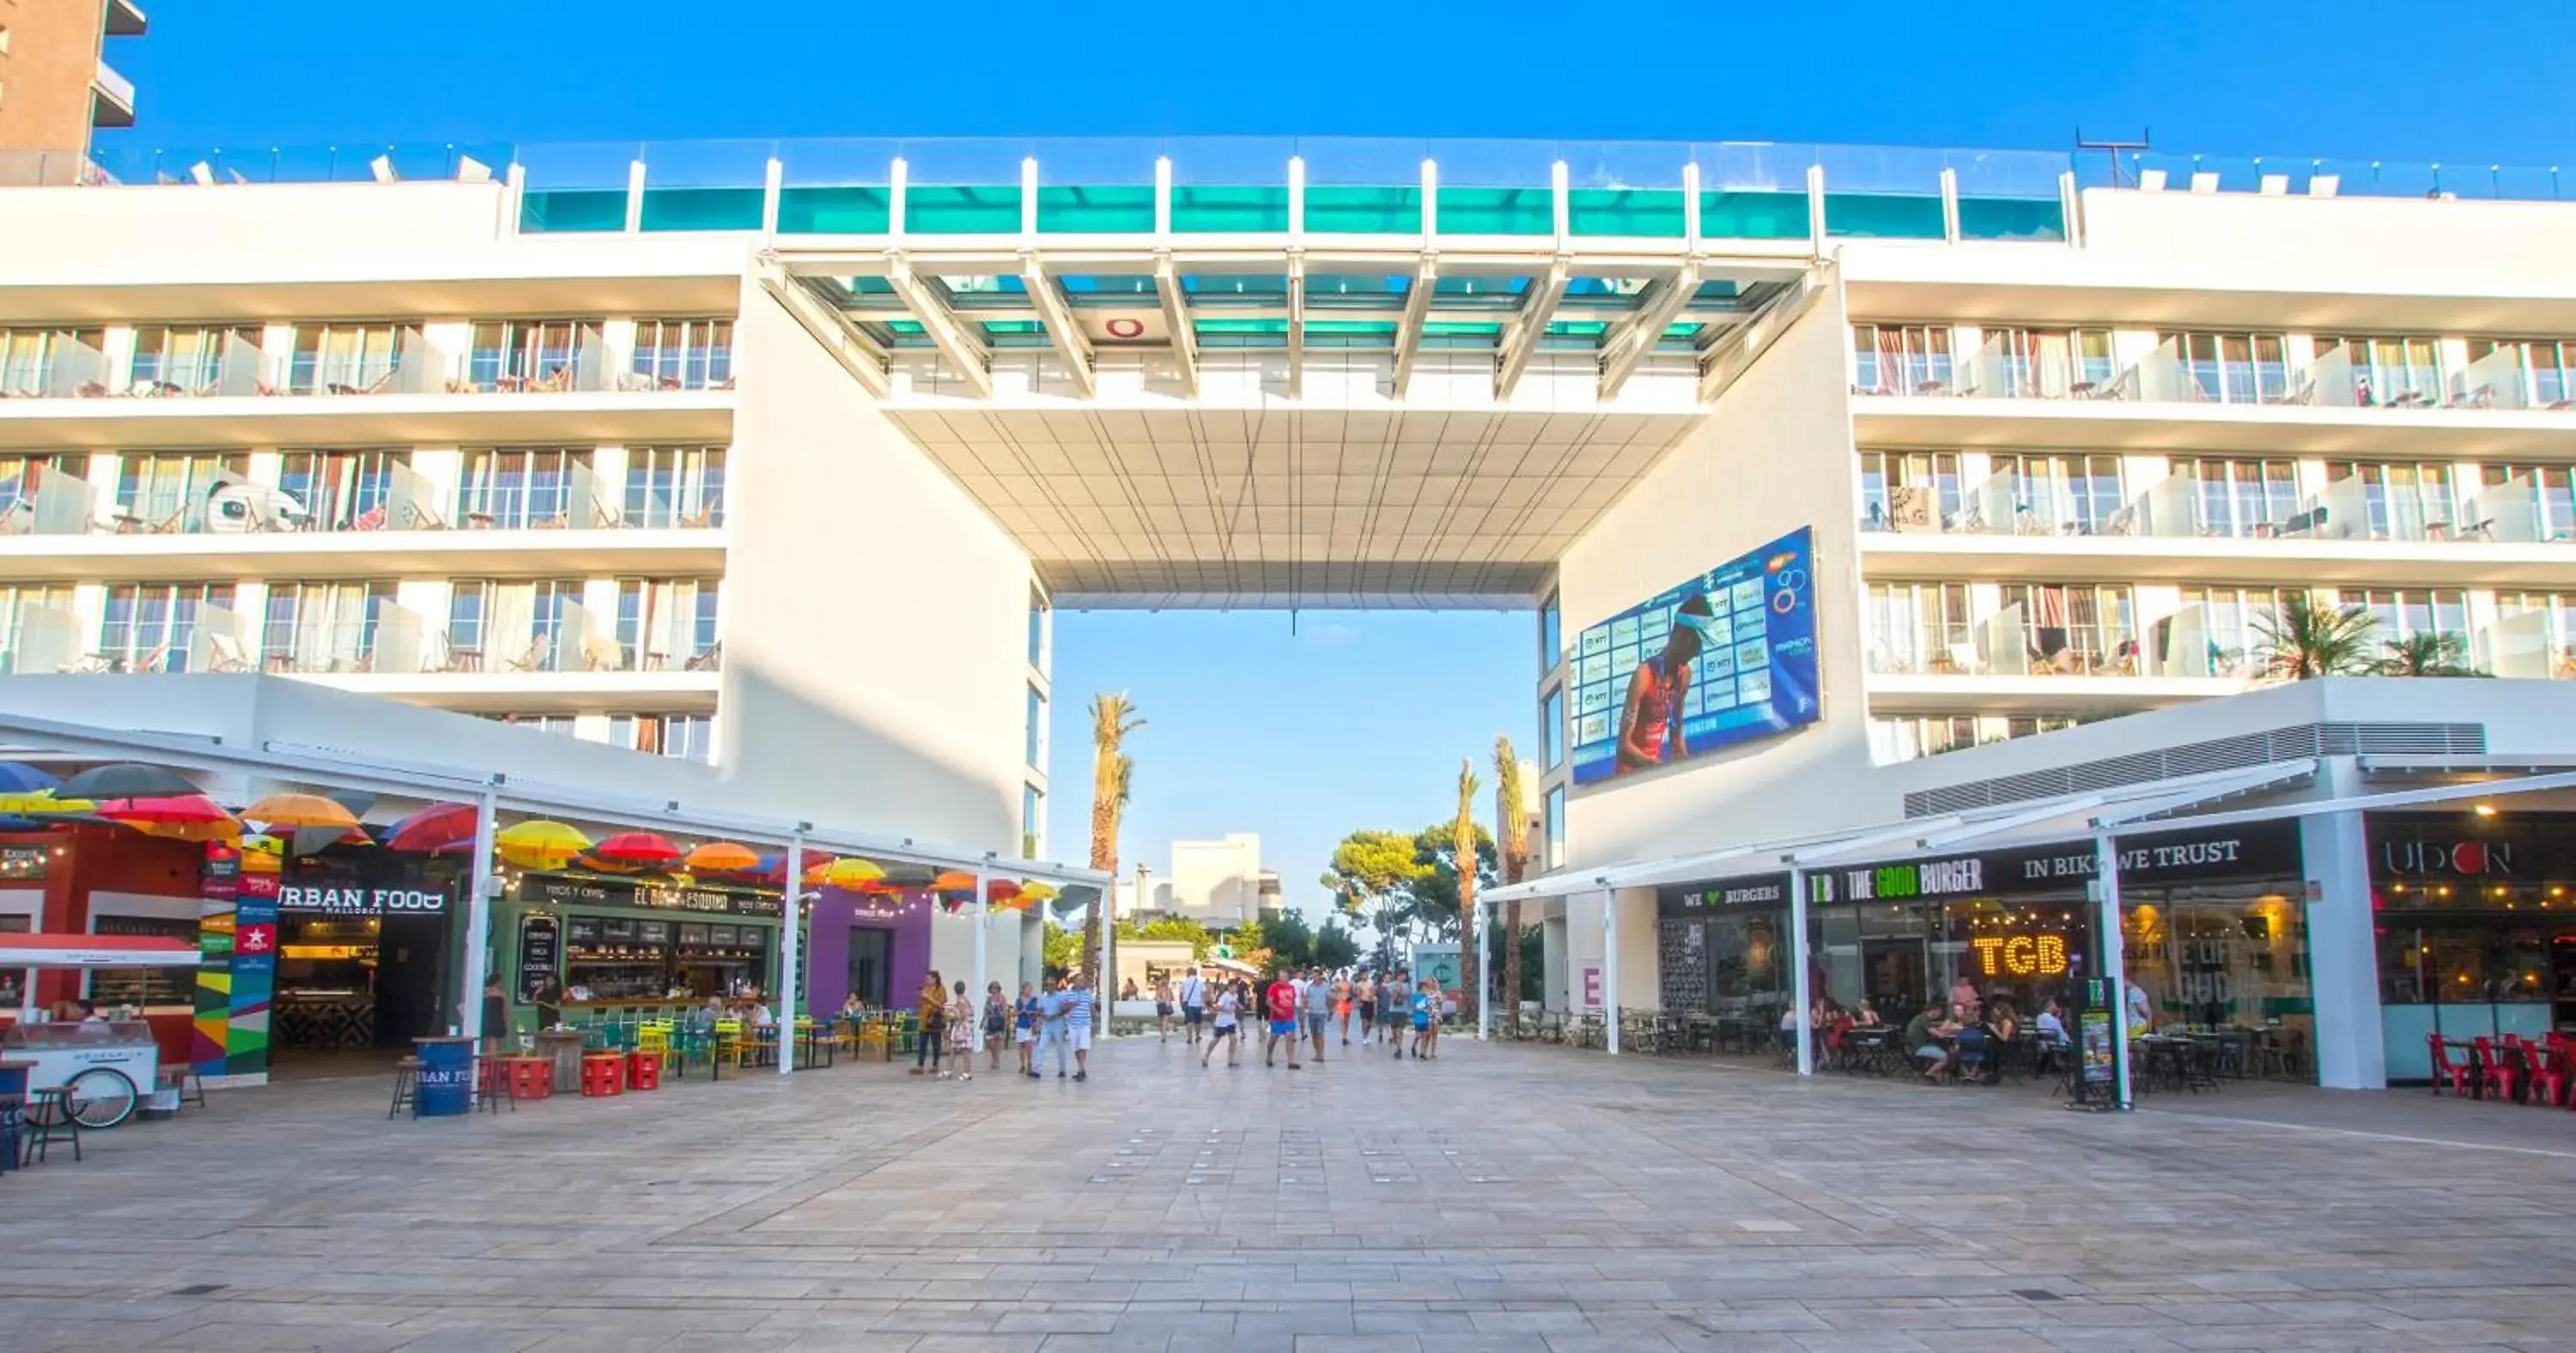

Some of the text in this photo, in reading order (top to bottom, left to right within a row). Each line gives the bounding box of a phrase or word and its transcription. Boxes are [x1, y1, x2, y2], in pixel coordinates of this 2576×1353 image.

[2024, 860, 2048, 878] IN
[2054, 854, 2100, 876] BIK
[2154, 840, 2240, 866] TRUST
[1848, 870, 1874, 901] THE
[1875, 865, 1917, 898] GOOD
[1920, 858, 1984, 895] BURGER
[373, 889, 443, 909] FOOD
[635, 886, 647, 905] EL
[1684, 885, 1780, 907] WE BURGERS
[1973, 934, 2067, 975] TGB
